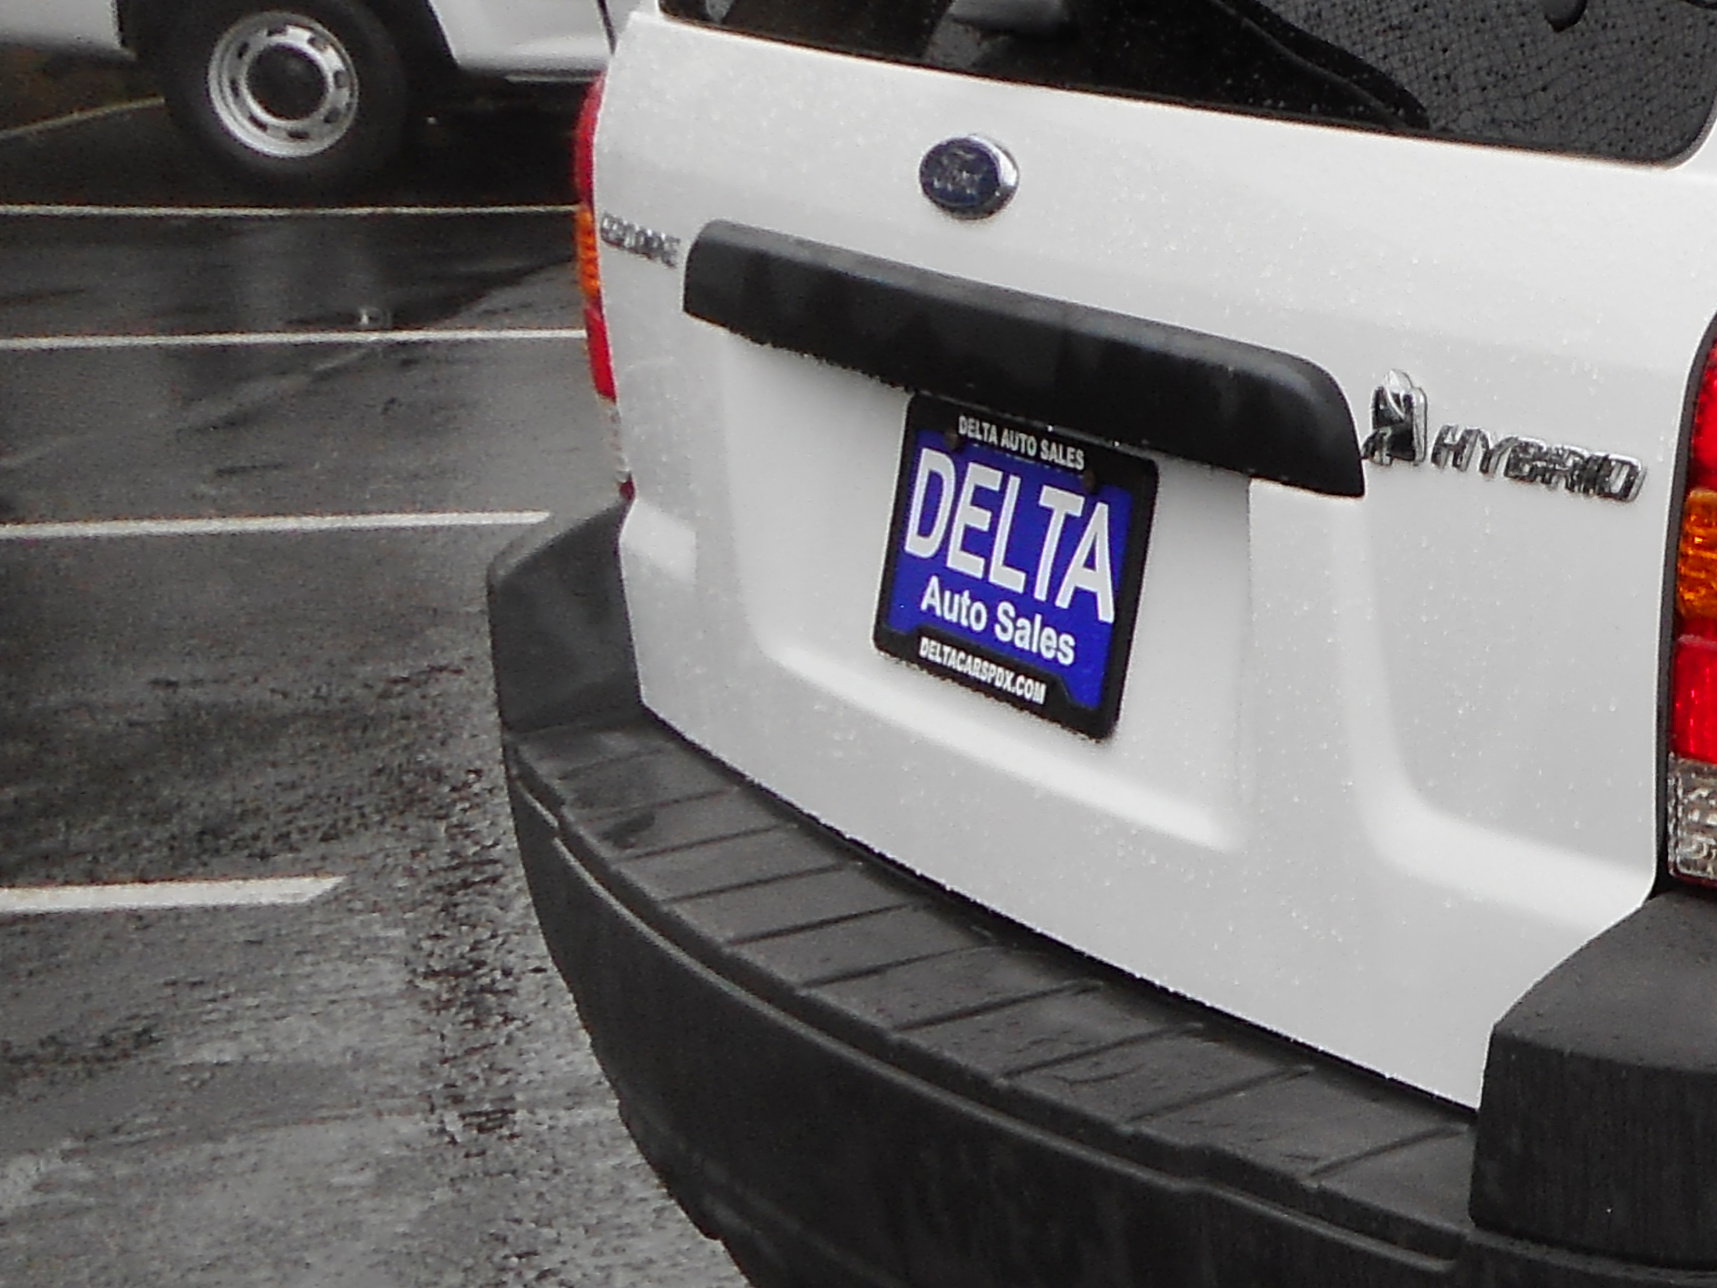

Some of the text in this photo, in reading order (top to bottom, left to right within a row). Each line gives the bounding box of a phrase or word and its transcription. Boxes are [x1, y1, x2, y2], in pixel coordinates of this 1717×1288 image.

[958, 415, 1086, 472] DELTA AUTO SALES
[1430, 424, 1648, 503] HYBRID
[904, 447, 1115, 624] DELTA
[920, 574, 1076, 666] Auto Sales
[918, 637, 1047, 705] DELTACARSPDX.COM
